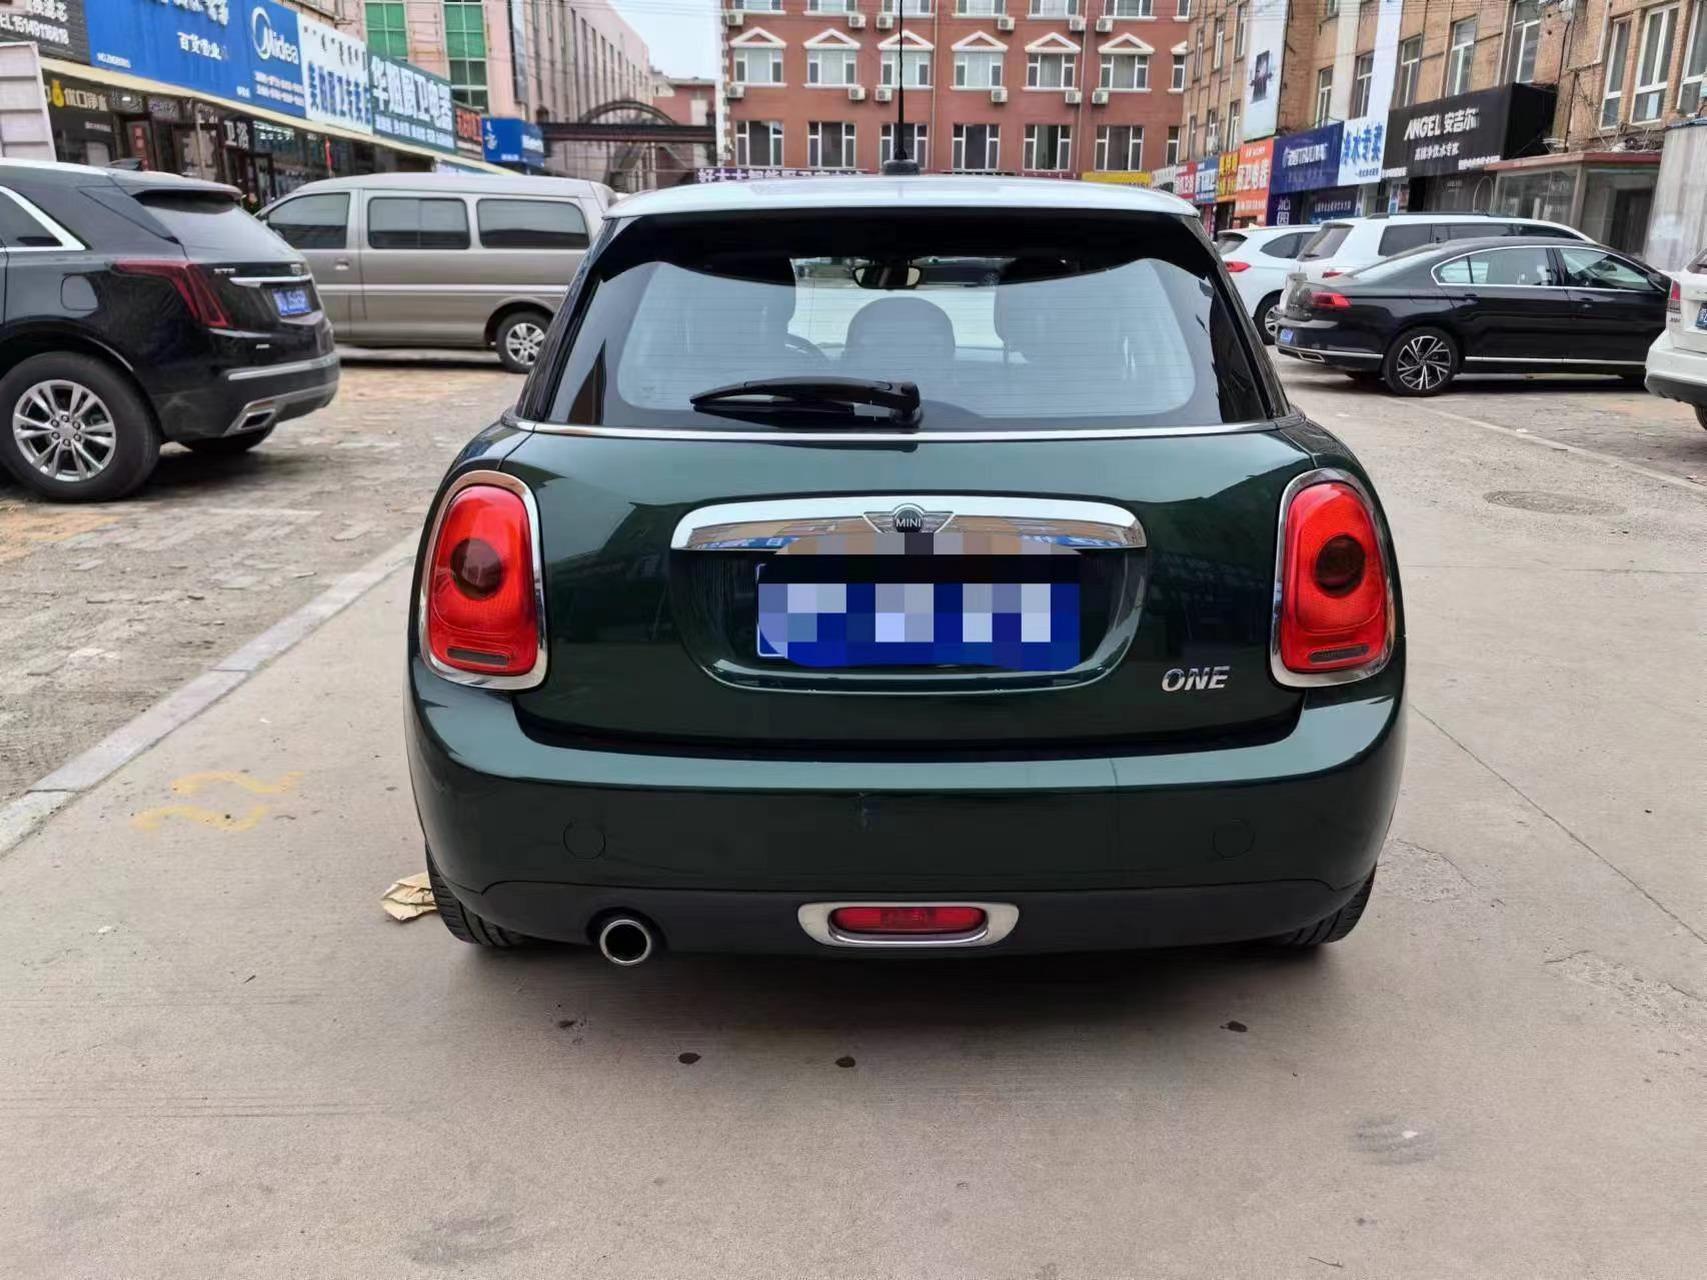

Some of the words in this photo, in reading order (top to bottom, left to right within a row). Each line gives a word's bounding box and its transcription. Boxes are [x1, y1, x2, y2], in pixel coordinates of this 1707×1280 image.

[252, 7, 299, 65] Midea
[1403, 113, 1441, 141] ANGEL
[1443, 107, 1480, 134] 安吉尔
[895, 517, 921, 528] MINI
[1161, 665, 1231, 692] ONE
